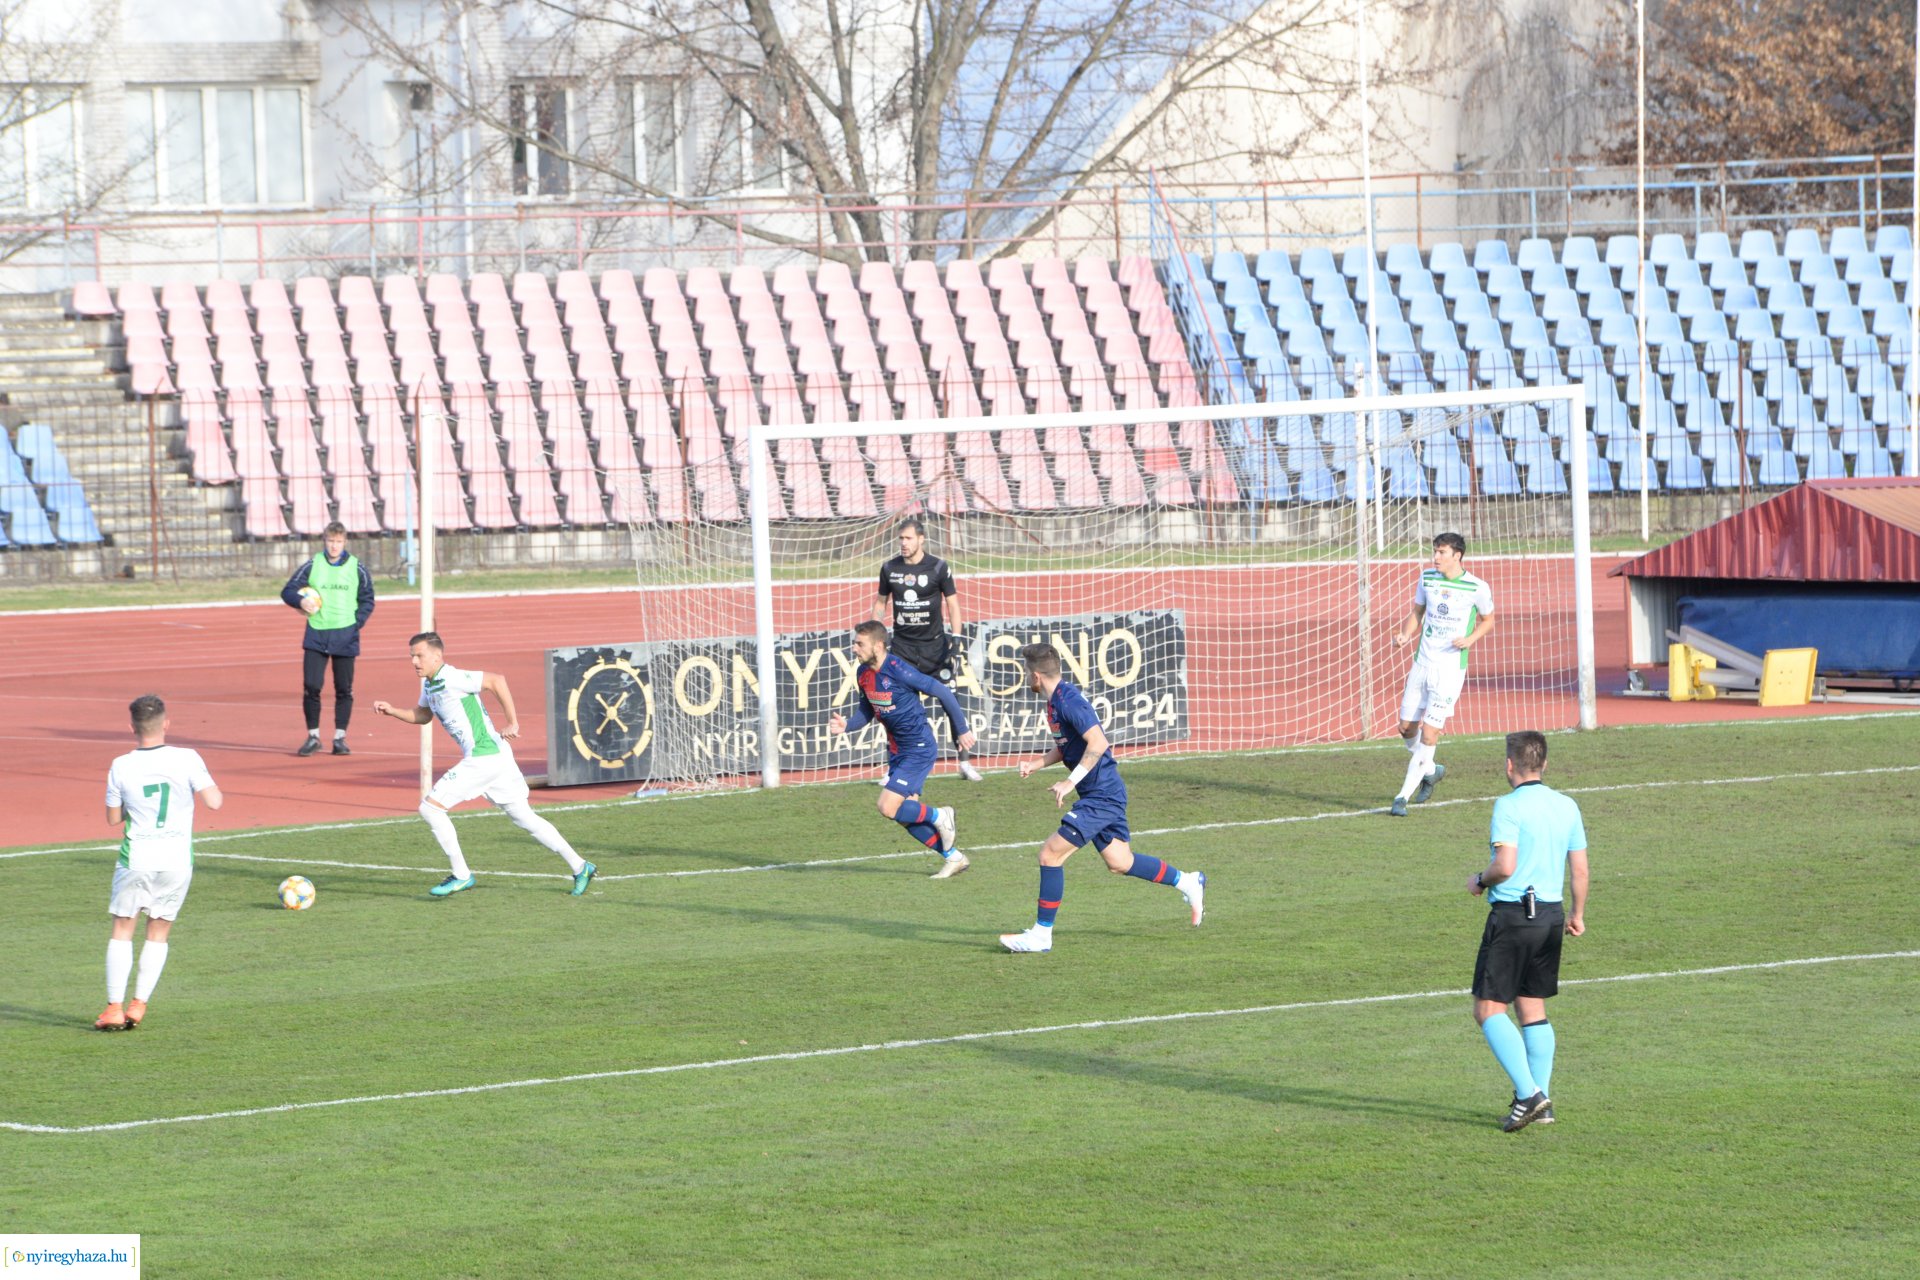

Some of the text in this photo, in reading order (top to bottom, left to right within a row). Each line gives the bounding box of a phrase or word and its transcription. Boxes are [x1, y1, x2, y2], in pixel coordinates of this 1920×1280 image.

[674, 628, 1142, 716] ONYX ASNO
[693, 716, 888, 762] NYÍRGYHÁZA
[143, 782, 170, 829] 7
